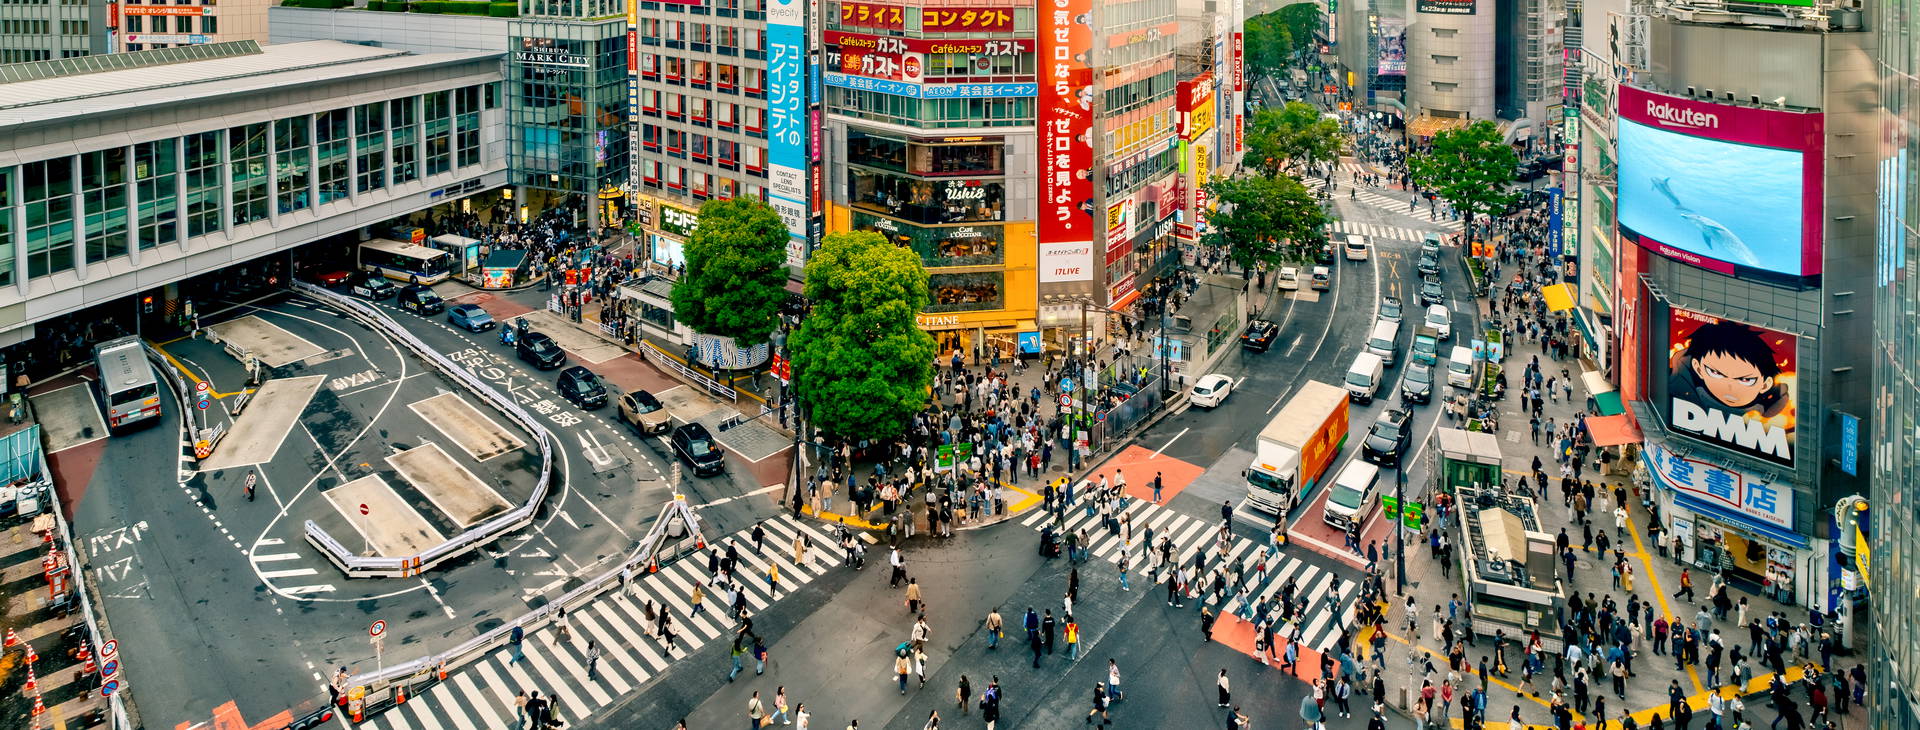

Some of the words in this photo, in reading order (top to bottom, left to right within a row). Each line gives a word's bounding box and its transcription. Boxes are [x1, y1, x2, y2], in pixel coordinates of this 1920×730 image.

[771, 7, 799, 20] eyecity
[842, 5, 903, 25] プライス
[923, 10, 1011, 27] コンタクト
[533, 46, 569, 54] SHIBUYA
[877, 37, 908, 54] ガスト
[984, 40, 1025, 56] ガスト
[516, 52, 553, 62] MARK
[558, 55, 590, 65] CITY
[827, 52, 841, 65] 7F
[861, 54, 899, 77] ガスト
[770, 42, 787, 143] アイシティ
[849, 77, 904, 93] 英会話イーオン
[928, 87, 952, 96] AEON
[960, 85, 1036, 97] 英会話イーオン
[788, 45, 801, 146] コンタクトの
[1647, 100, 1718, 129] Rakuten
[776, 169, 798, 179] CONTACT
[781, 177, 793, 185] LENS
[1055, 118, 1072, 230] ゼロを見よう。
[773, 182, 802, 195] SPECIALISTS
[944, 187, 985, 200] Ushi8
[1155, 217, 1174, 240] LUSH
[1659, 245, 1680, 257] Rakuten
[1681, 250, 1701, 264] Vision
[1672, 397, 1791, 460] DMM
